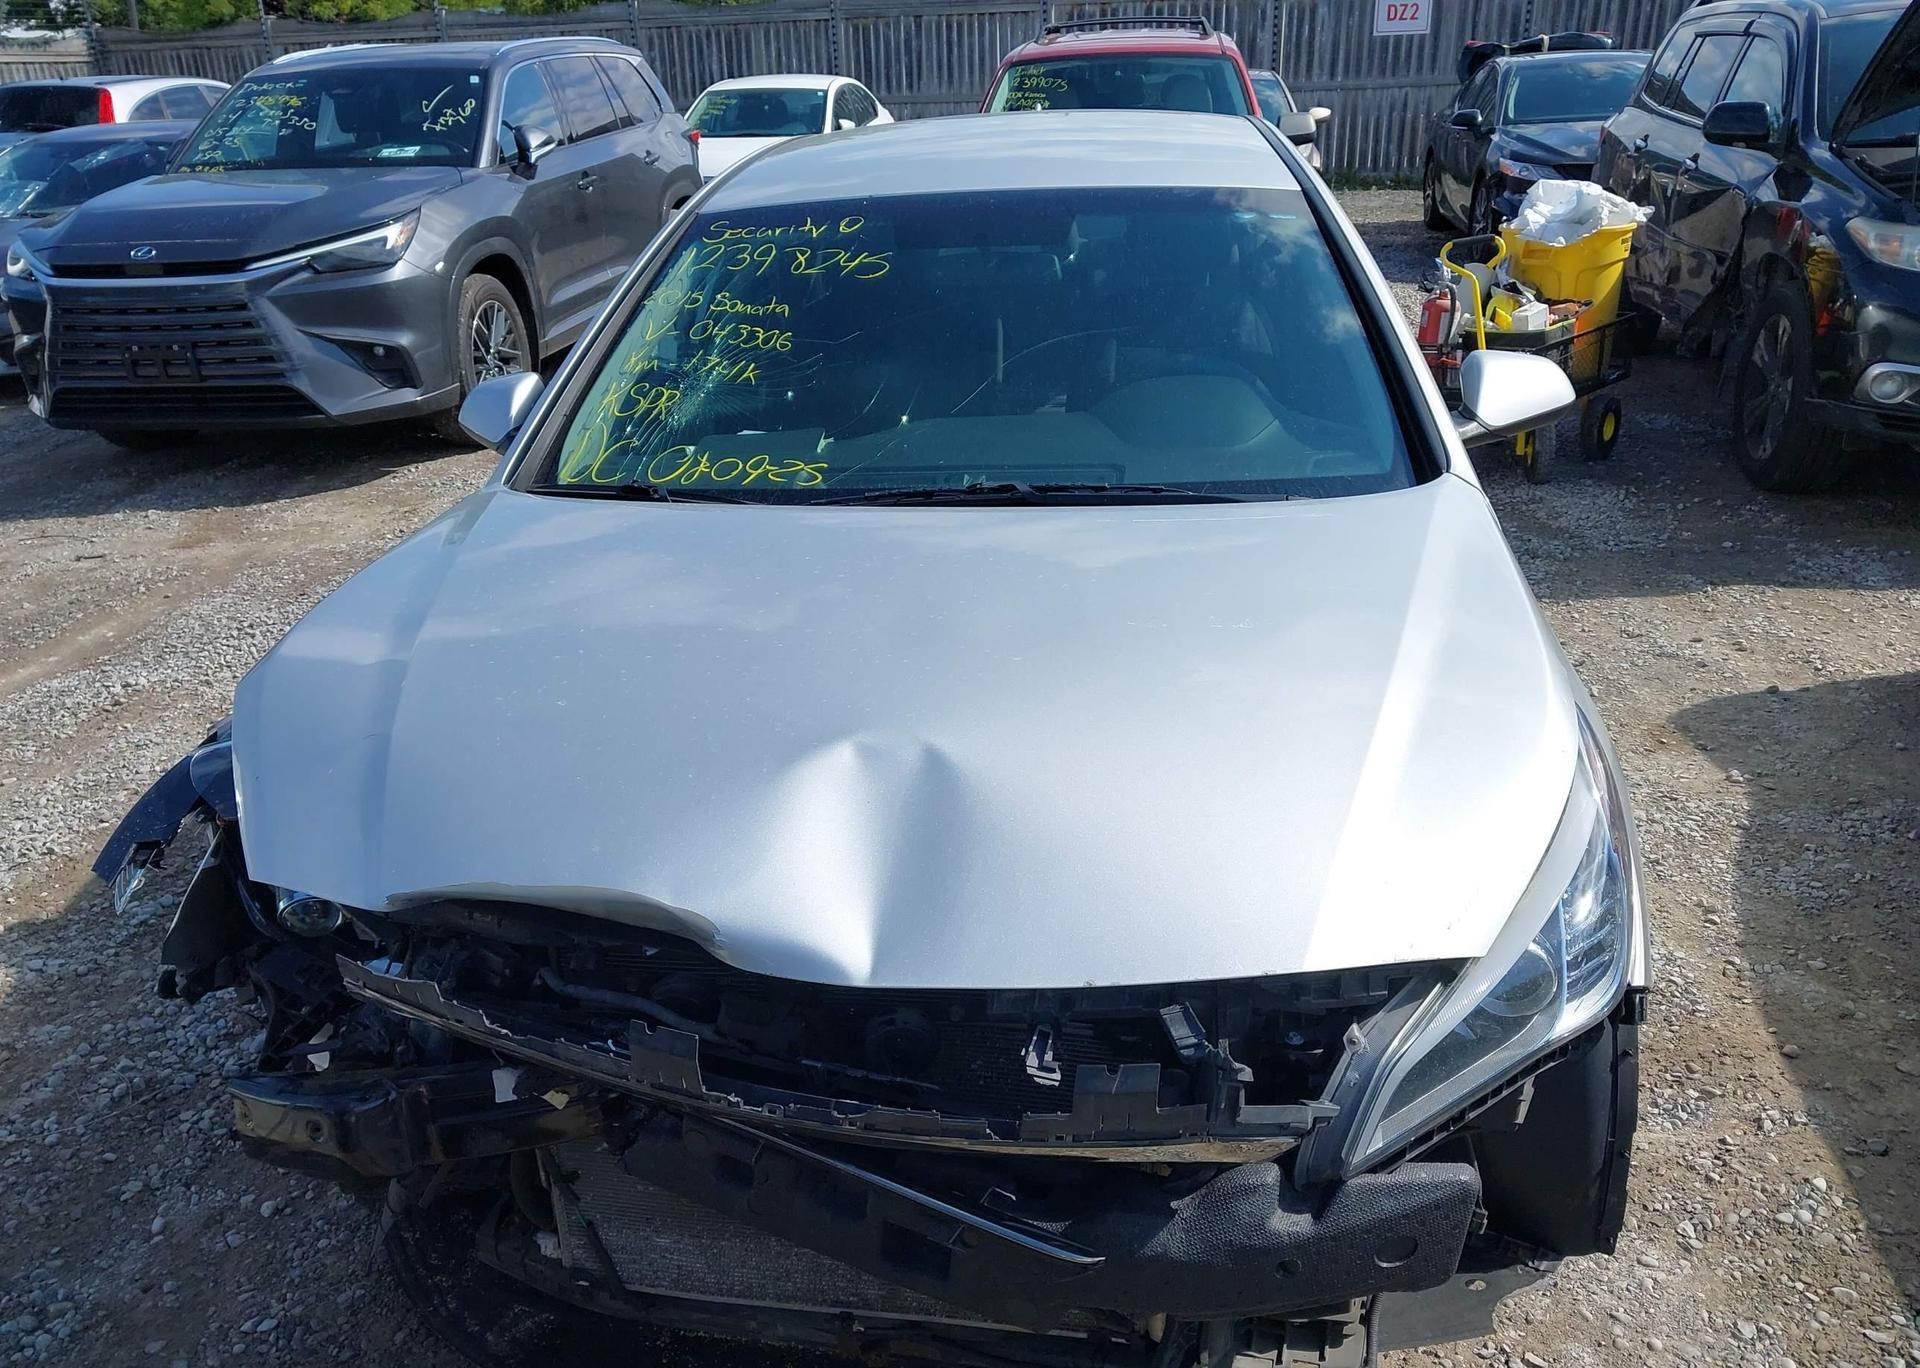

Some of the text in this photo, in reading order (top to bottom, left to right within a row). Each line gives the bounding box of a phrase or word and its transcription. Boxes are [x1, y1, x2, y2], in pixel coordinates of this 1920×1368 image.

[1387, 3, 1419, 21] DZ2
[702, 216, 827, 243] Security
[710, 292, 791, 318] Sonata
[689, 319, 793, 351] 043306
